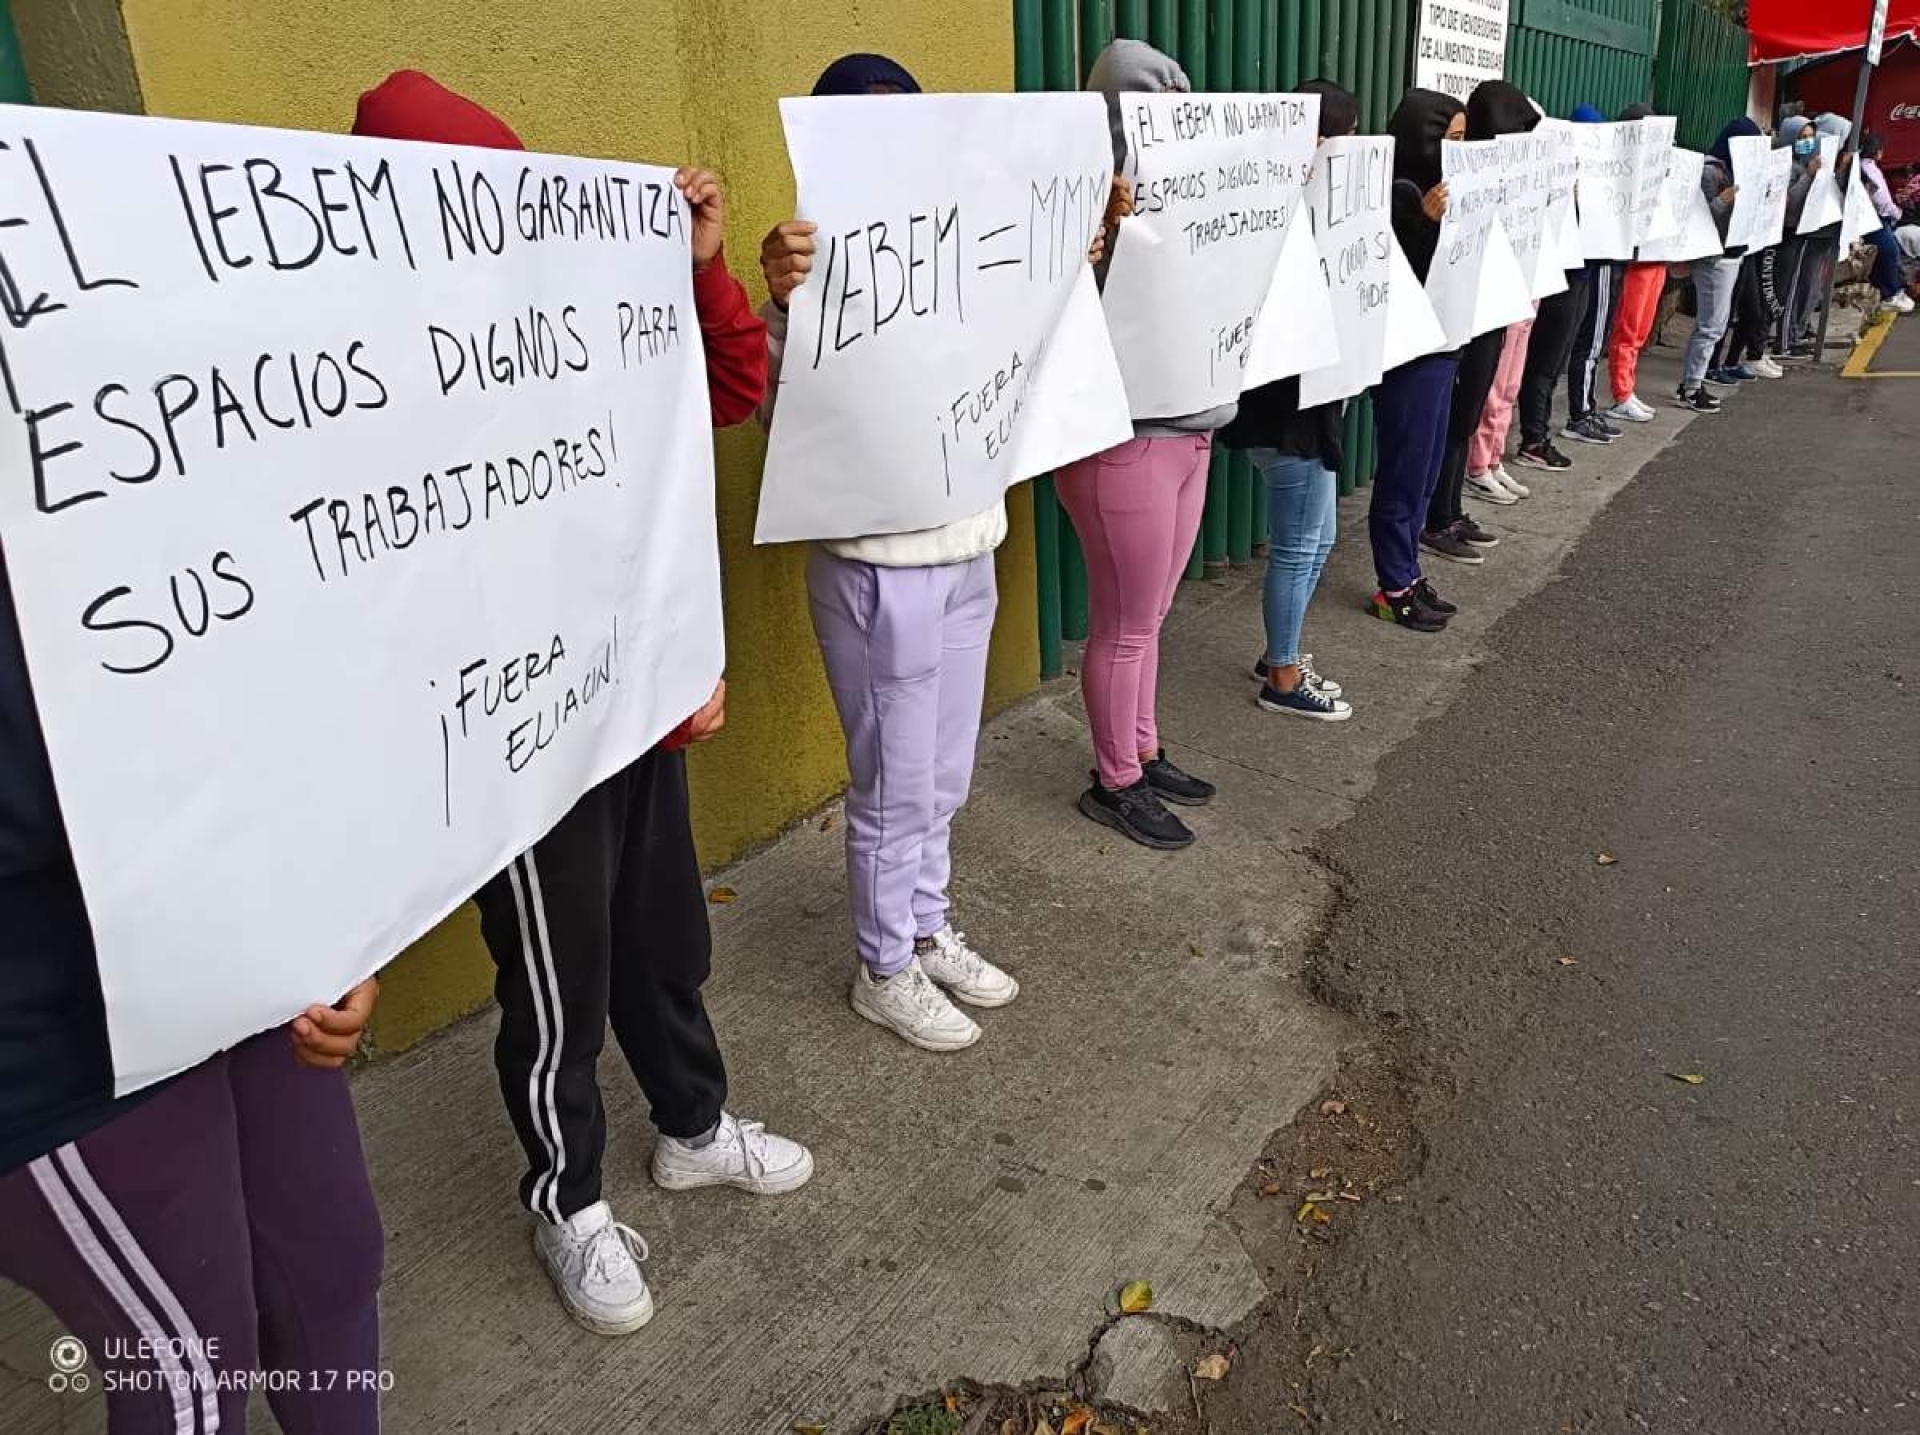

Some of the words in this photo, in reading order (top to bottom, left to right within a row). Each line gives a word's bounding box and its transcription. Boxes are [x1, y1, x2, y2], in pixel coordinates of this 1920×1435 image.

[1421, 35, 1432, 58] DE
[1447, 9, 1459, 31] DE
[1223, 102, 1243, 138] NO
[168, 154, 417, 283] IEBEM
[432, 160, 504, 261] NO
[516, 167, 684, 244] GARANTIZA
[1134, 171, 1205, 216] ESPACIOS
[1217, 159, 1259, 191] DIGNOS
[1266, 161, 1292, 185] PARA
[812, 202, 965, 371] IEBEM
[24, 341, 388, 514] ESPACIOS
[427, 304, 589, 396] DIGNOS
[617, 302, 679, 369] PARA
[81, 551, 254, 674] SUS
[289, 410, 620, 582] TRABAJADORES!
